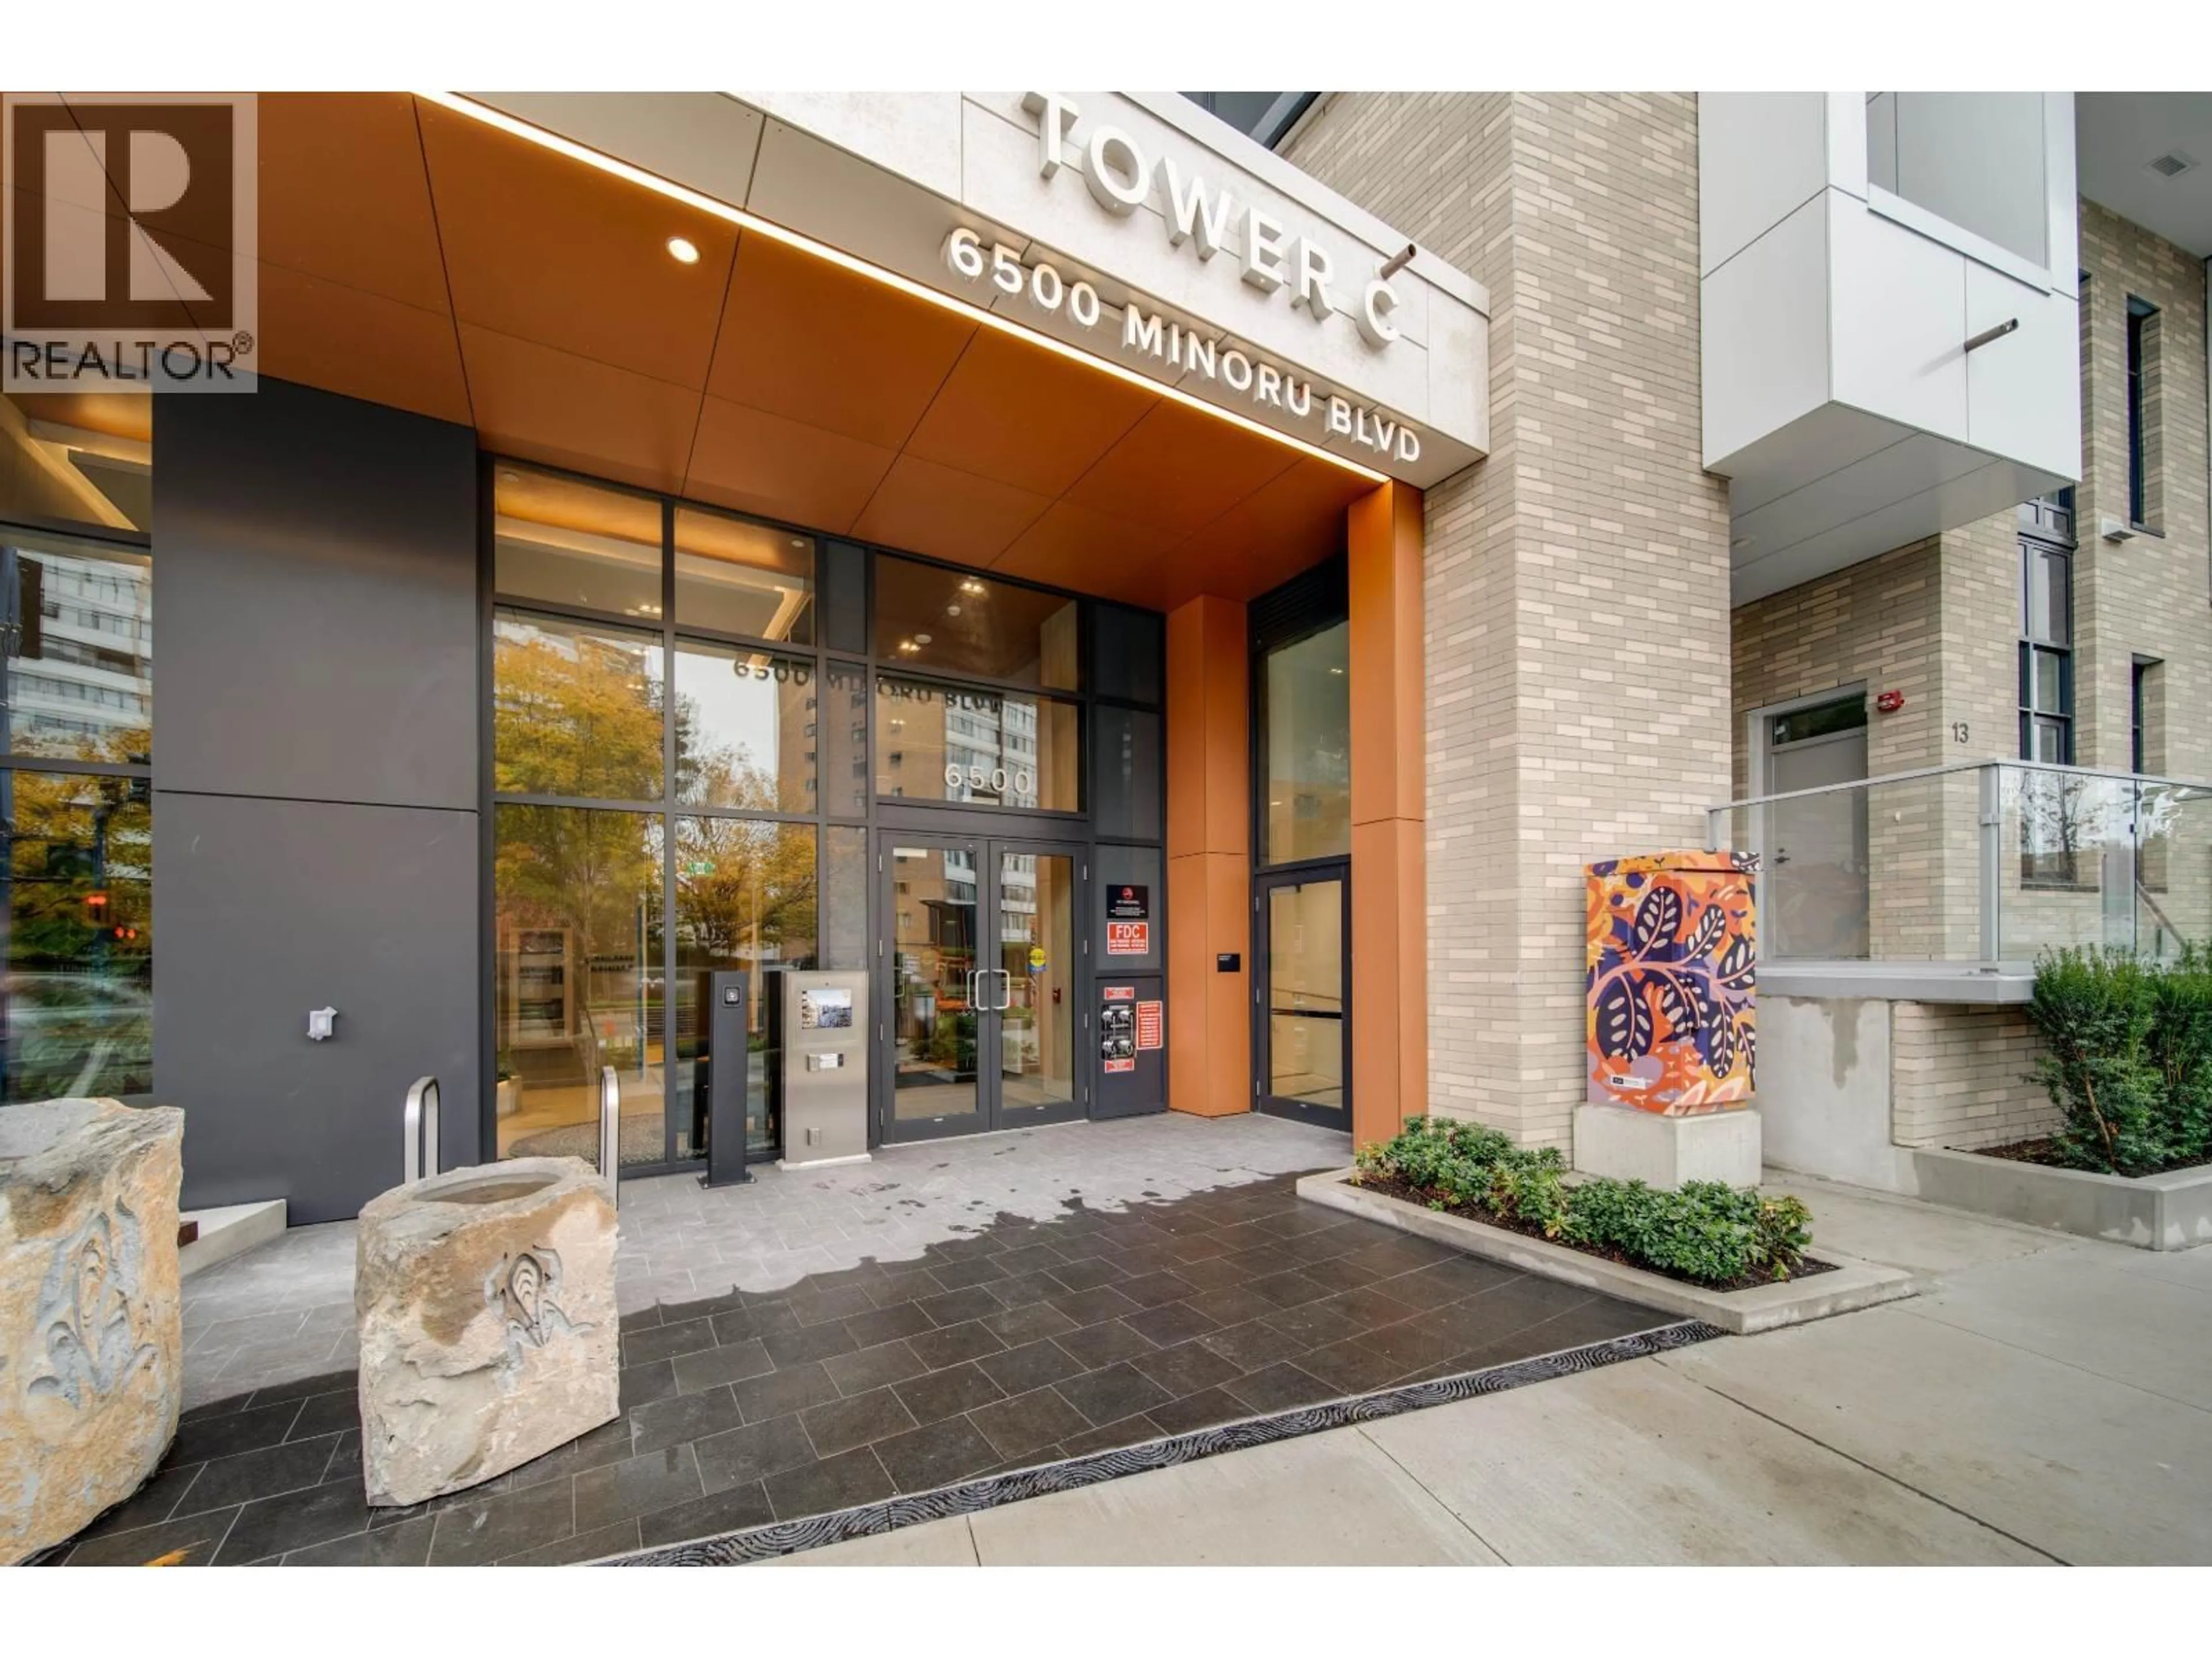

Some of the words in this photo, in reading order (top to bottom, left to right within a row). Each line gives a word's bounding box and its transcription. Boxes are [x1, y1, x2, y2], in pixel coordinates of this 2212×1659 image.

[1021, 91, 1334, 320] TOWER
[1355, 279, 1400, 345] C
[947, 228, 1100, 327] 6500
[1122, 304, 1310, 416] MINORU
[1326, 395, 1420, 463] BLVD
[1952, 722, 1969, 743] 13
[945, 763, 1031, 793] 6500
[1116, 925, 1140, 938] FDC
